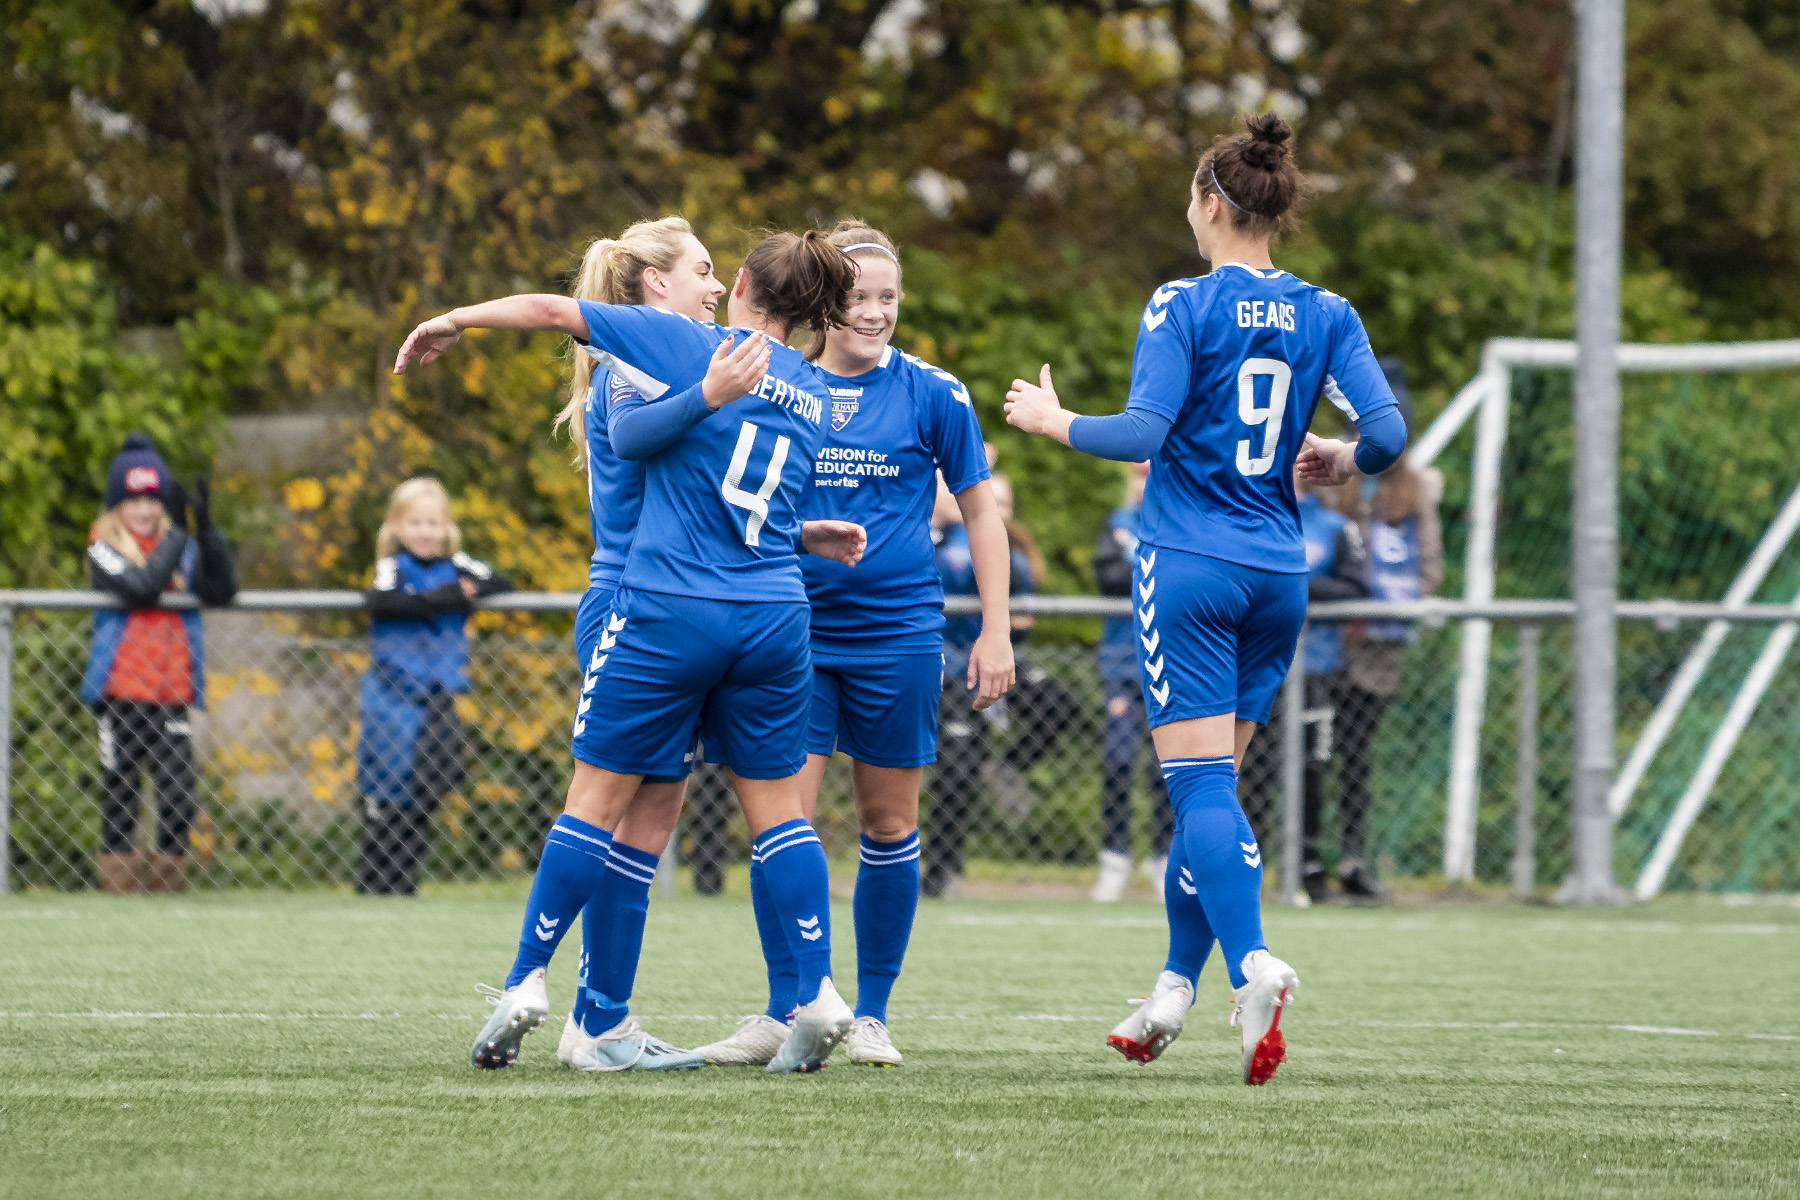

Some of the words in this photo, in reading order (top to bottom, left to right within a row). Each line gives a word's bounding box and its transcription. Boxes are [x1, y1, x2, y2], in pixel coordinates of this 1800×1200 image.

[1236, 300, 1296, 331] GEARS
[1235, 357, 1292, 477] 9
[817, 447, 866, 461] VISION
[867, 449, 889, 463] for
[815, 461, 900, 477] EDUCATION
[721, 420, 791, 547] 4
[814, 478, 833, 488] part
[833, 478, 843, 487] of
[843, 476, 859, 488] tes
